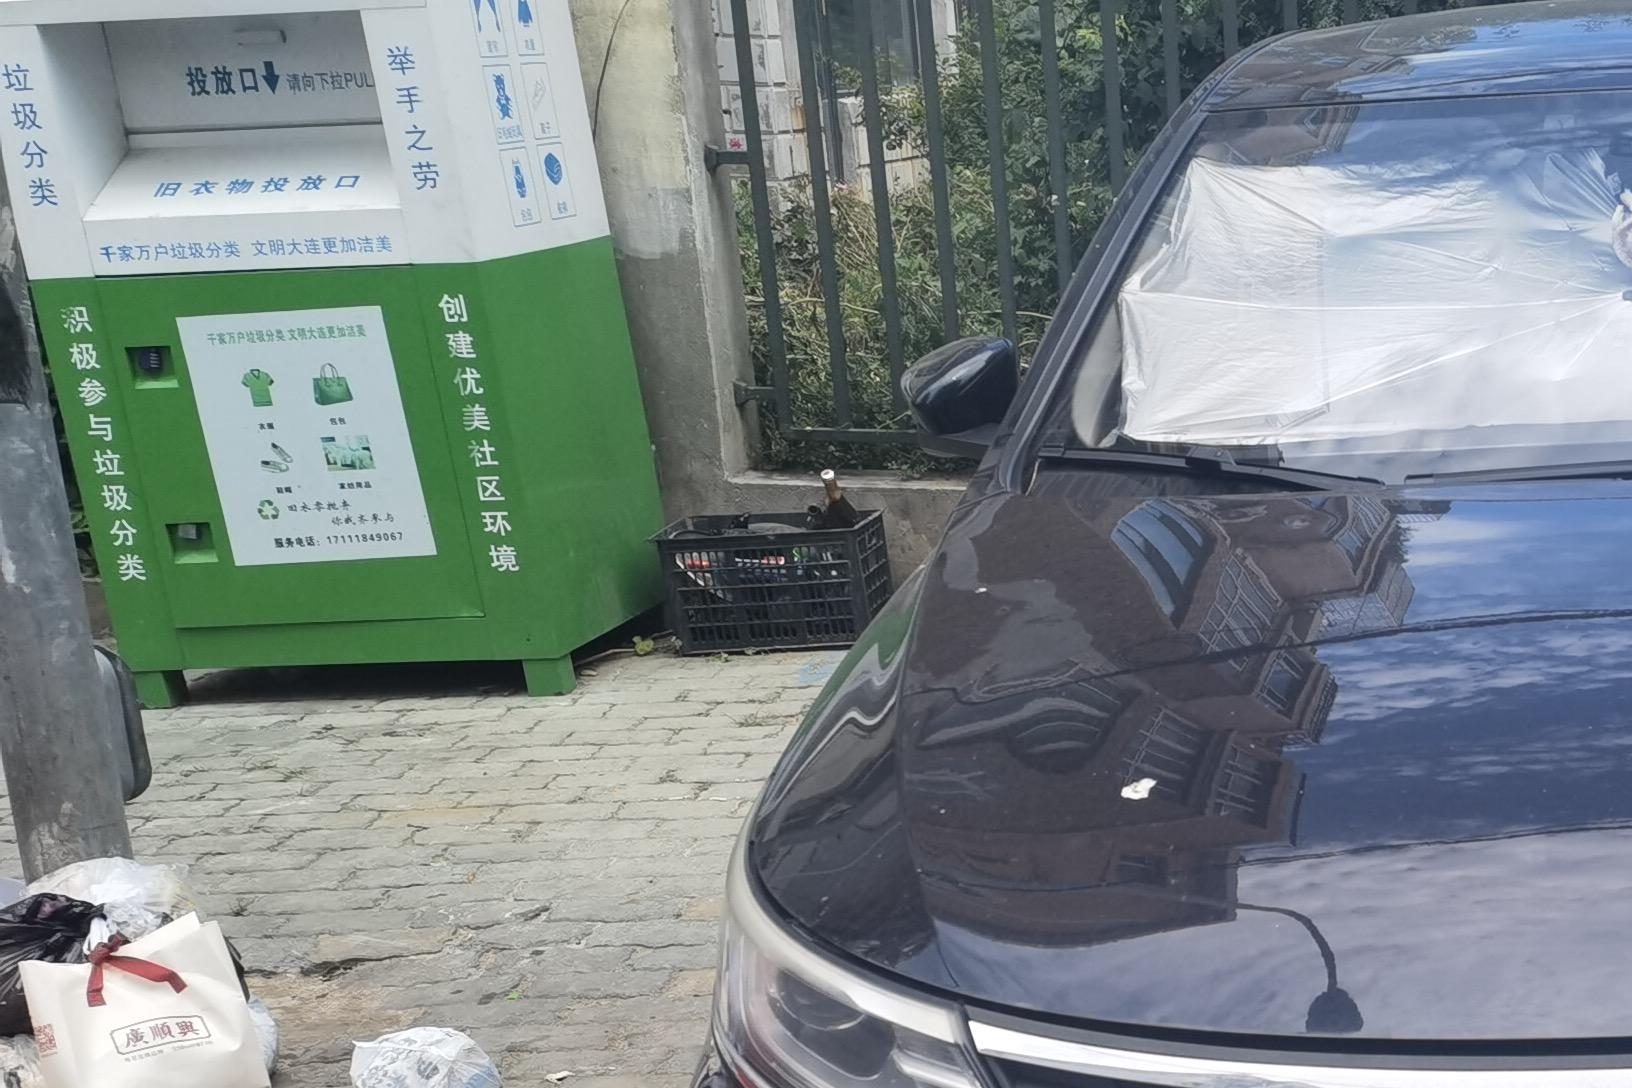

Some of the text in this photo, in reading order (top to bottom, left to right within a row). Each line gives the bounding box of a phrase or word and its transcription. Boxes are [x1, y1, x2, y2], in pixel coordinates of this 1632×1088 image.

[186, 64, 260, 96] 投放口
[386, 45, 440, 191] 举手之劳
[2, 63, 58, 207] 垃圾分类
[154, 174, 361, 198] 旧衣物投放口
[98, 235, 393, 263] 千家万户垃圾分类 文明大连更加洁美
[206, 324, 367, 346] 千家万户垃圾分类 文明大连更加洁美
[60, 306, 147, 582] 积极参与垃圾分类
[438, 293, 520, 572] 创建优美社区环境
